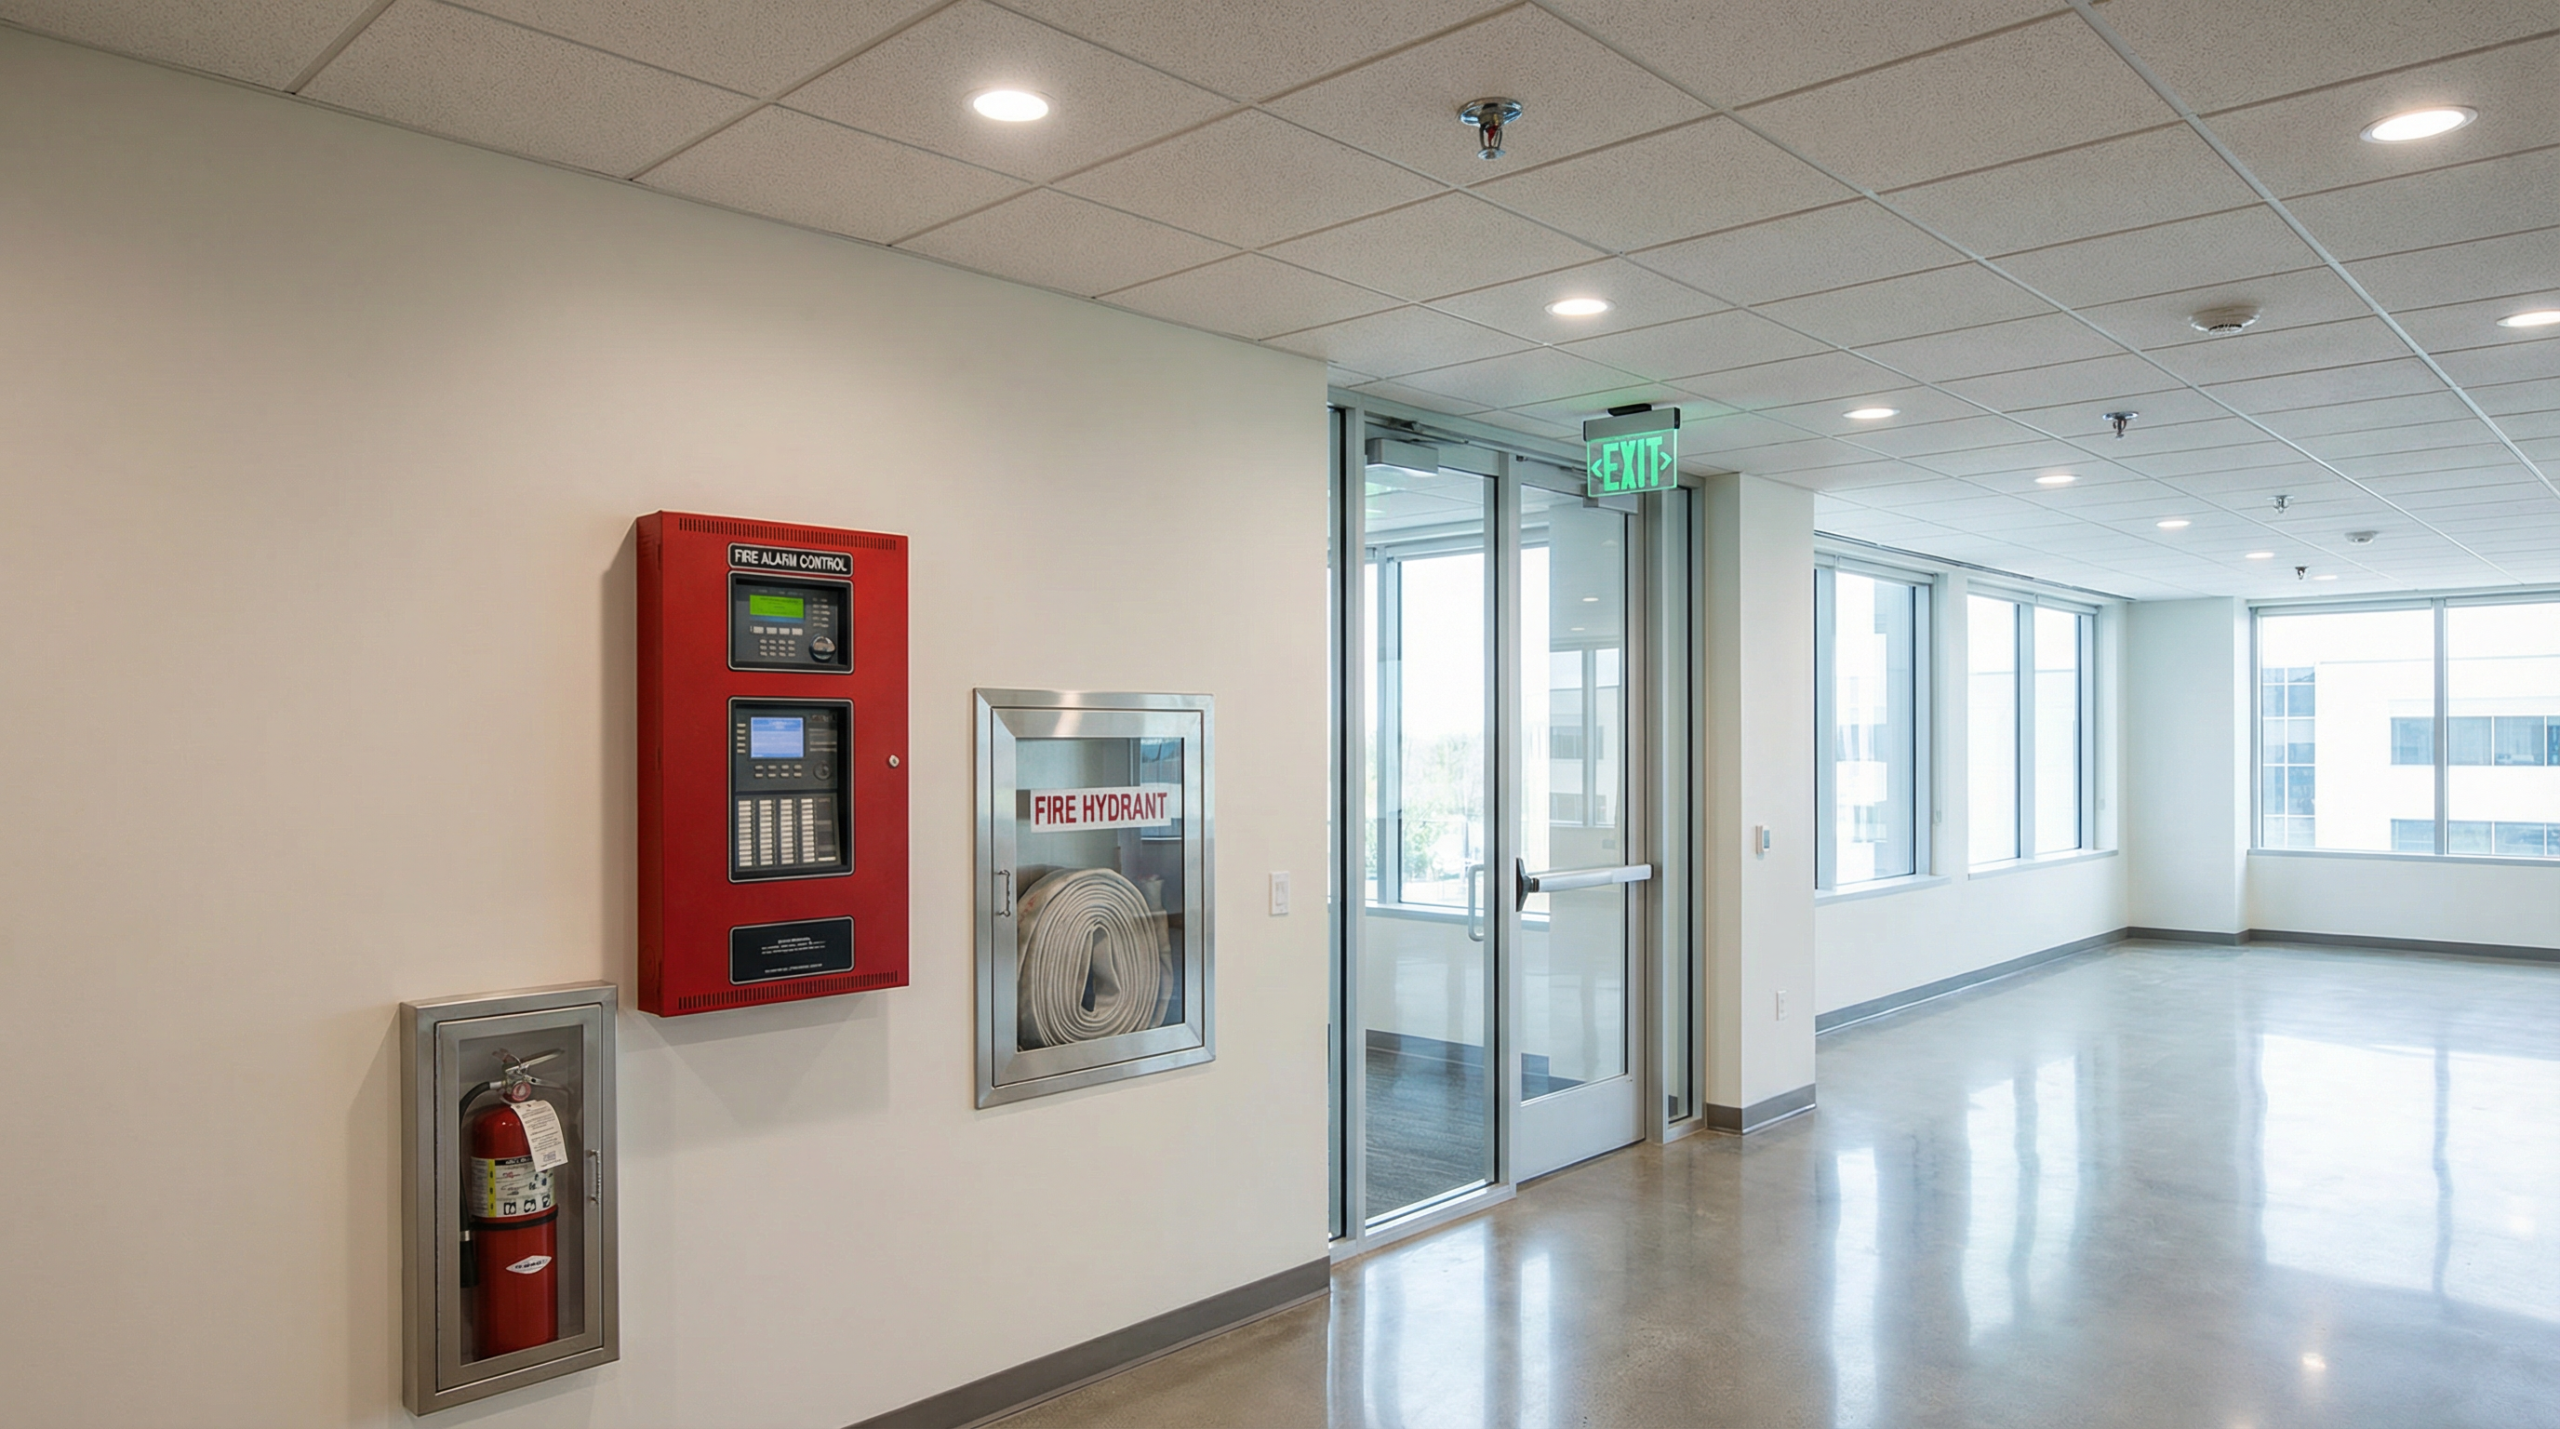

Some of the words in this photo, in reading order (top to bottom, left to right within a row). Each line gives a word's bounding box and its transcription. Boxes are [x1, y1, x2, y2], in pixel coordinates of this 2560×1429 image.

[1603, 436, 1663, 492] EXIT
[734, 549, 759, 564] FIRE
[761, 551, 797, 567] ALARM
[799, 554, 848, 572] CONTROL
[1035, 795, 1077, 825] FIRE
[1082, 792, 1168, 823] HYDRANT
